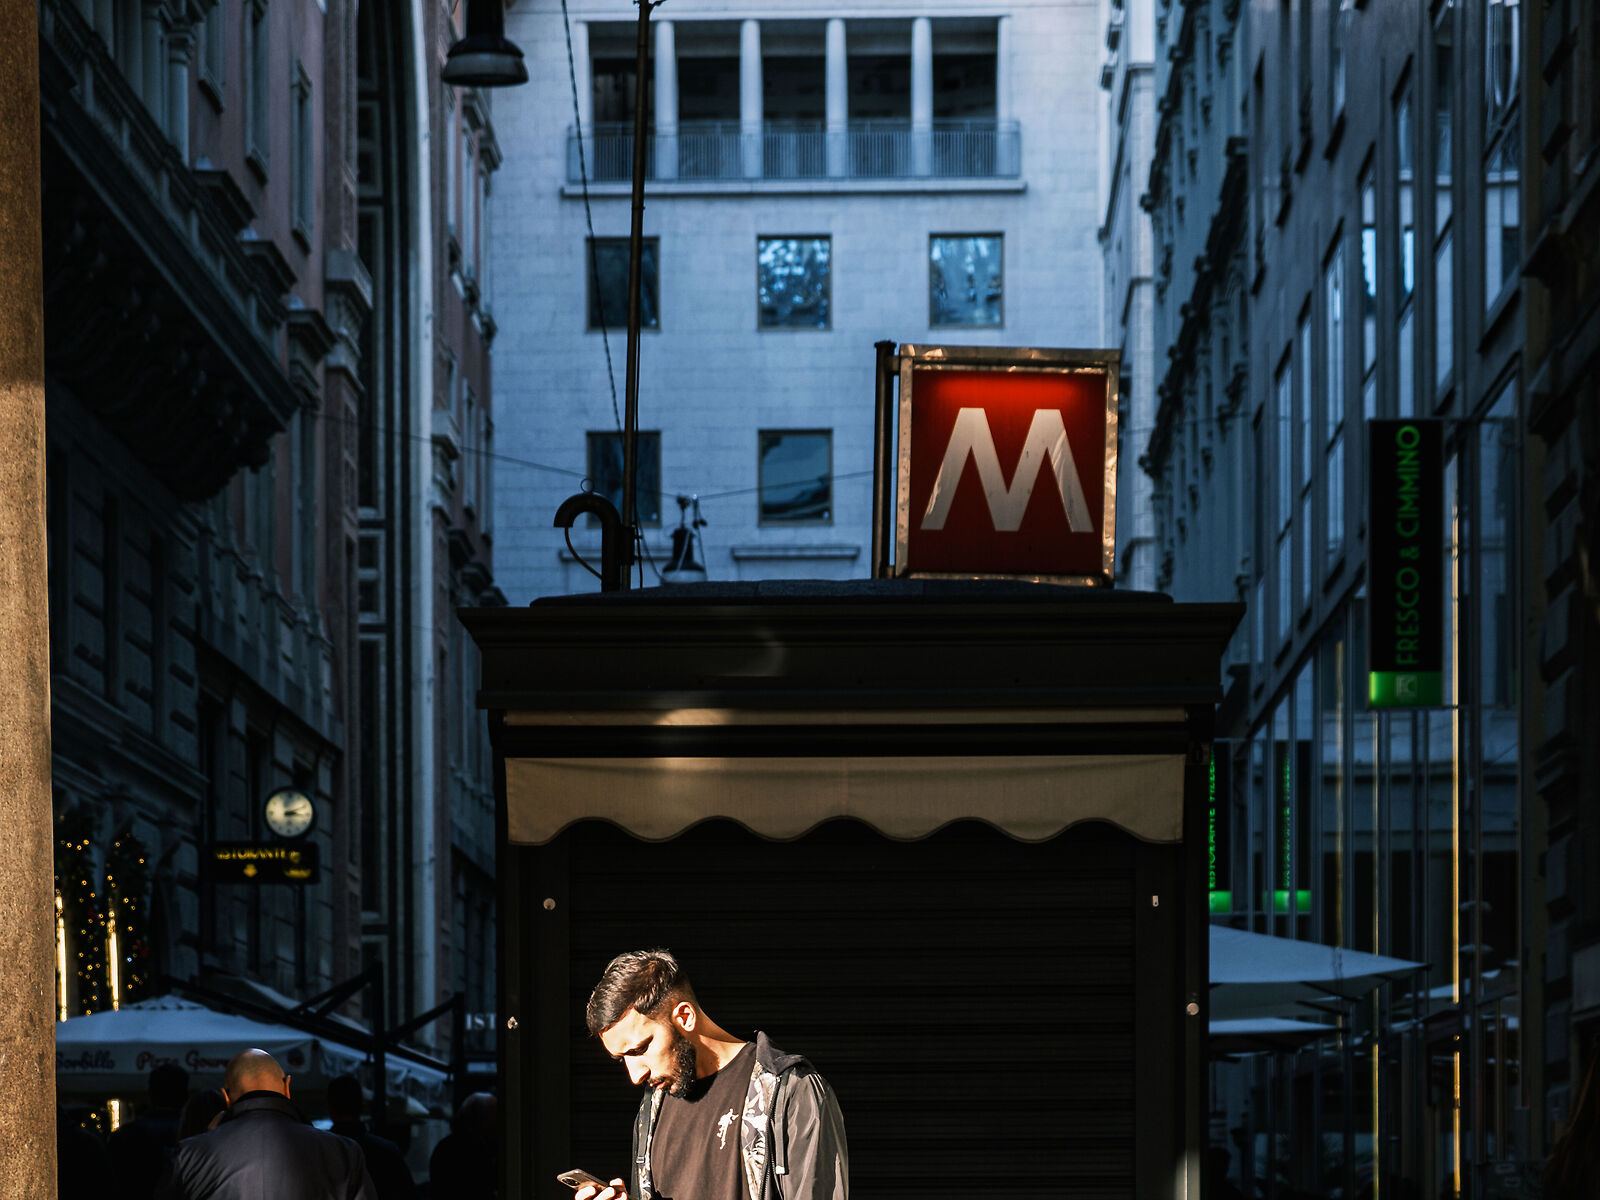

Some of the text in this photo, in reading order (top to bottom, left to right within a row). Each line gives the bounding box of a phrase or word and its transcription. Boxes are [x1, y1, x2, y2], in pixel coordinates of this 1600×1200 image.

[920, 407, 1094, 533] M
[1395, 425, 1420, 665] FRESCO & CIMMINO
